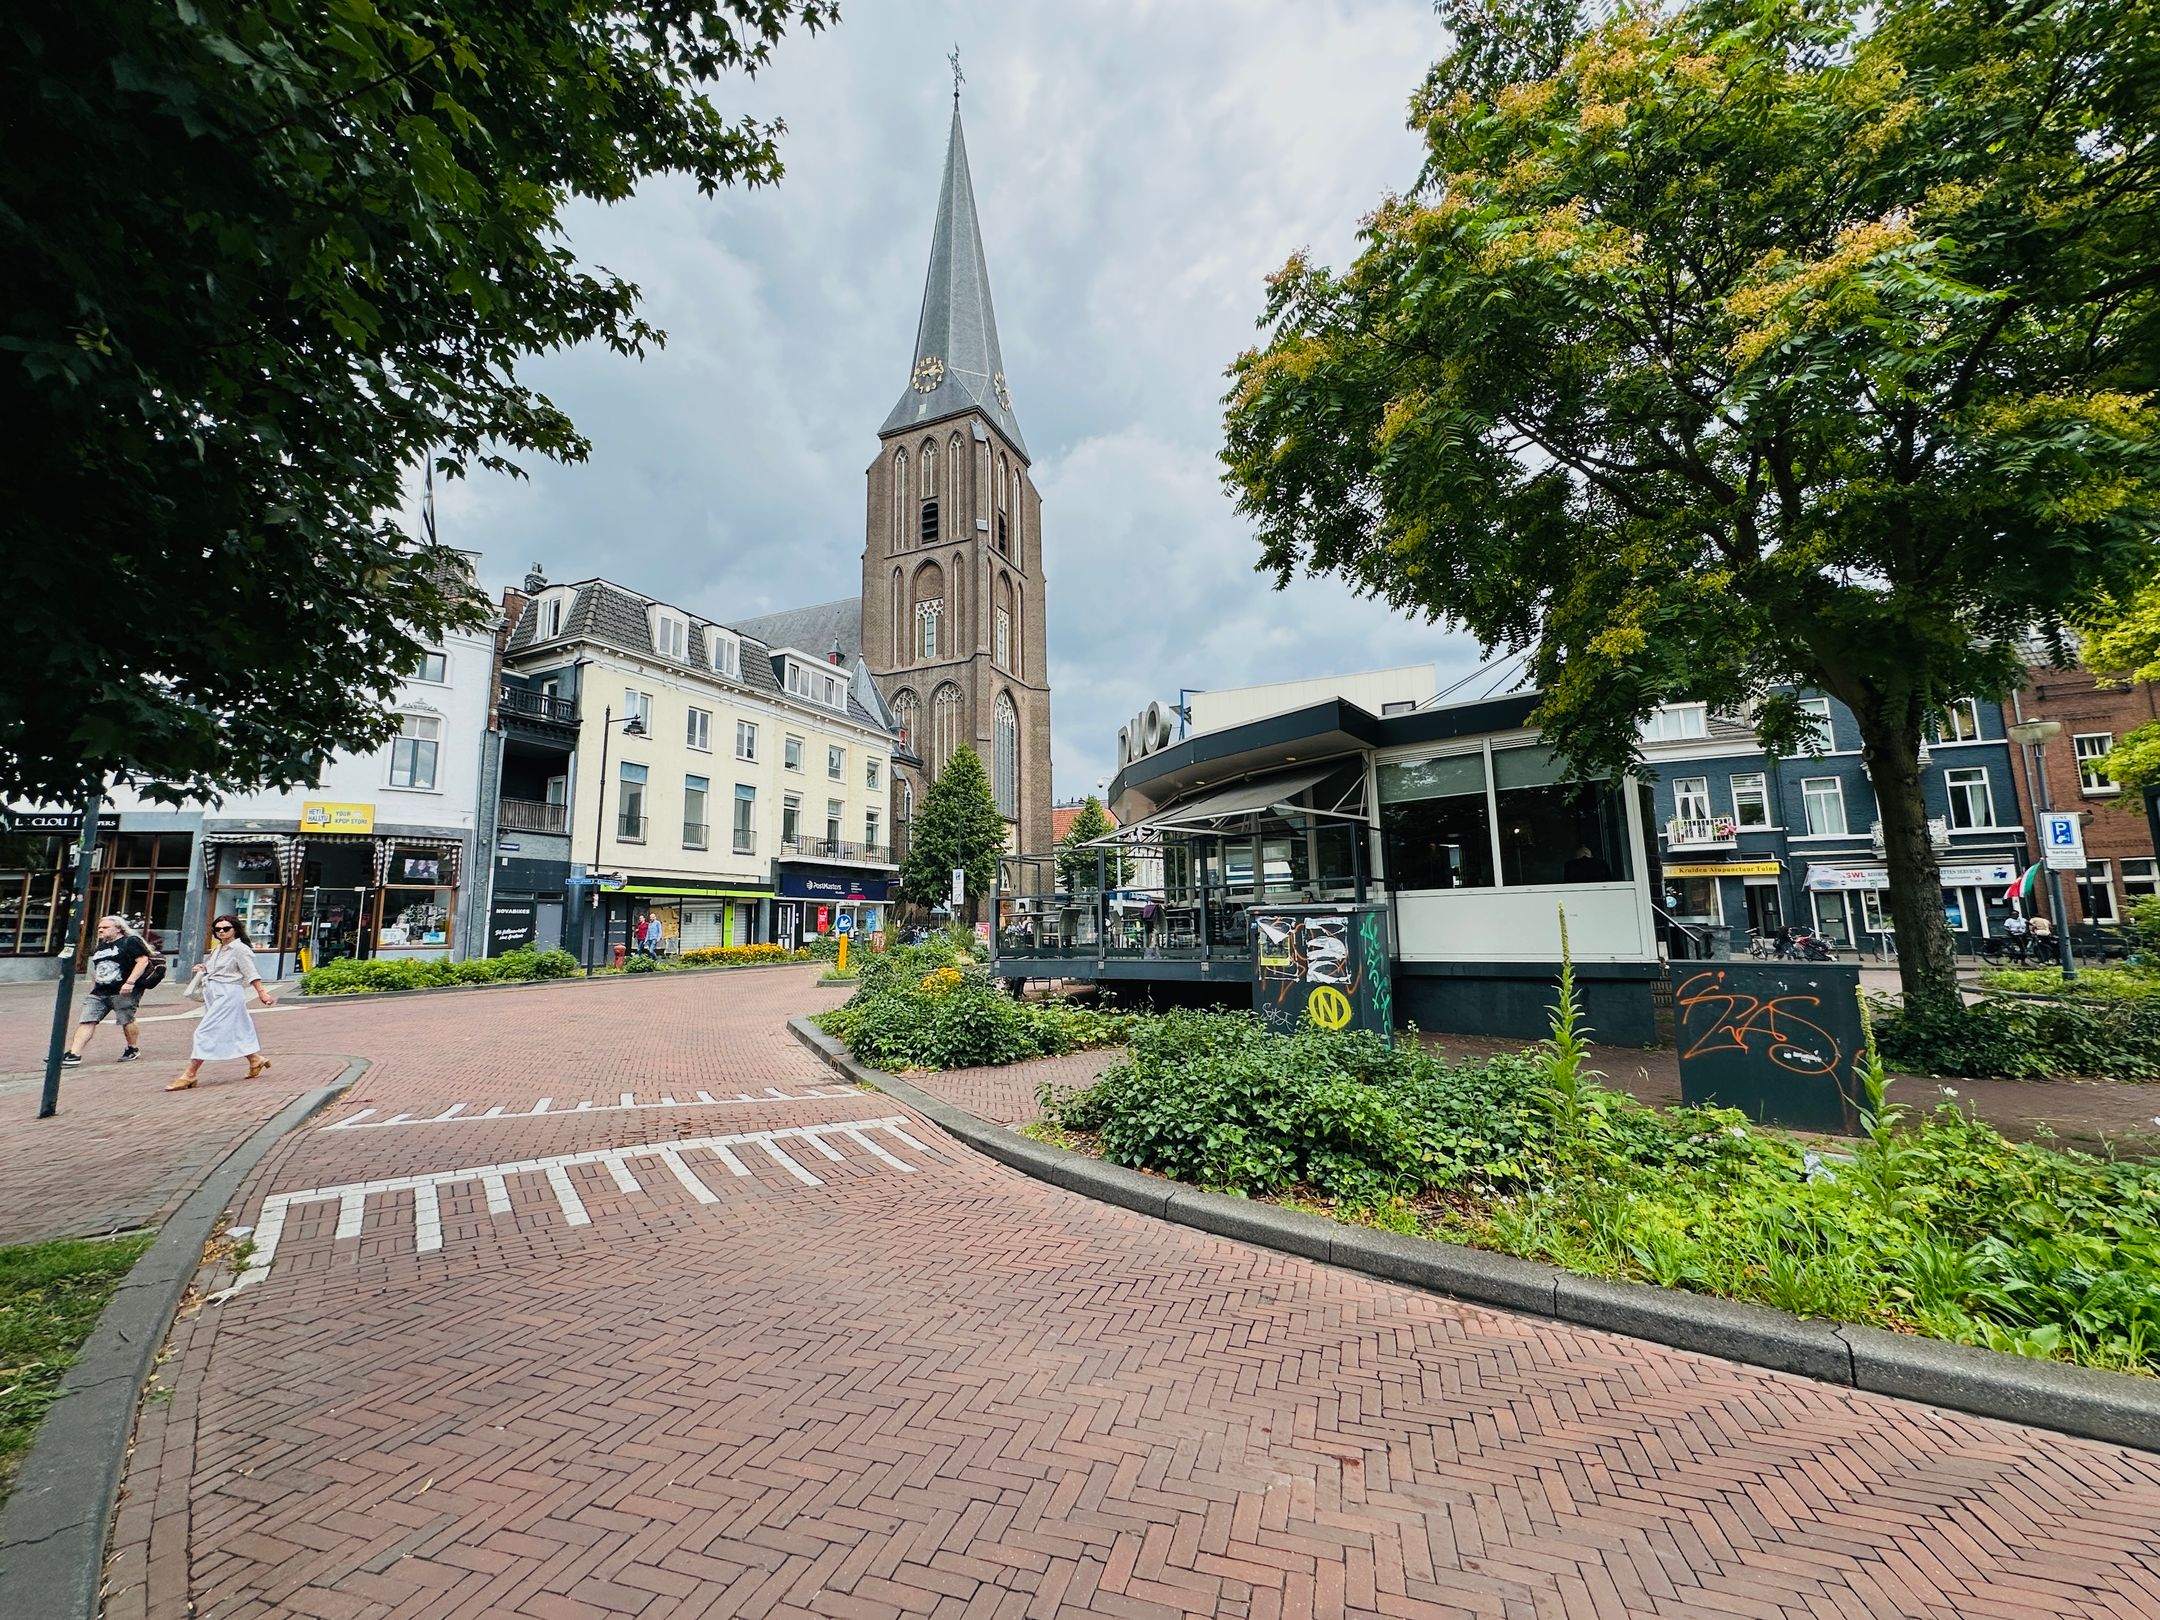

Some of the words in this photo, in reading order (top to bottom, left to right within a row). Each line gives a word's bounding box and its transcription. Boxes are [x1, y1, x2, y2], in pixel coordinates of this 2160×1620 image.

[1118, 700, 1169, 768] DUO
[2055, 823, 2067, 835] P
[813, 882, 842, 890] PostMasters
